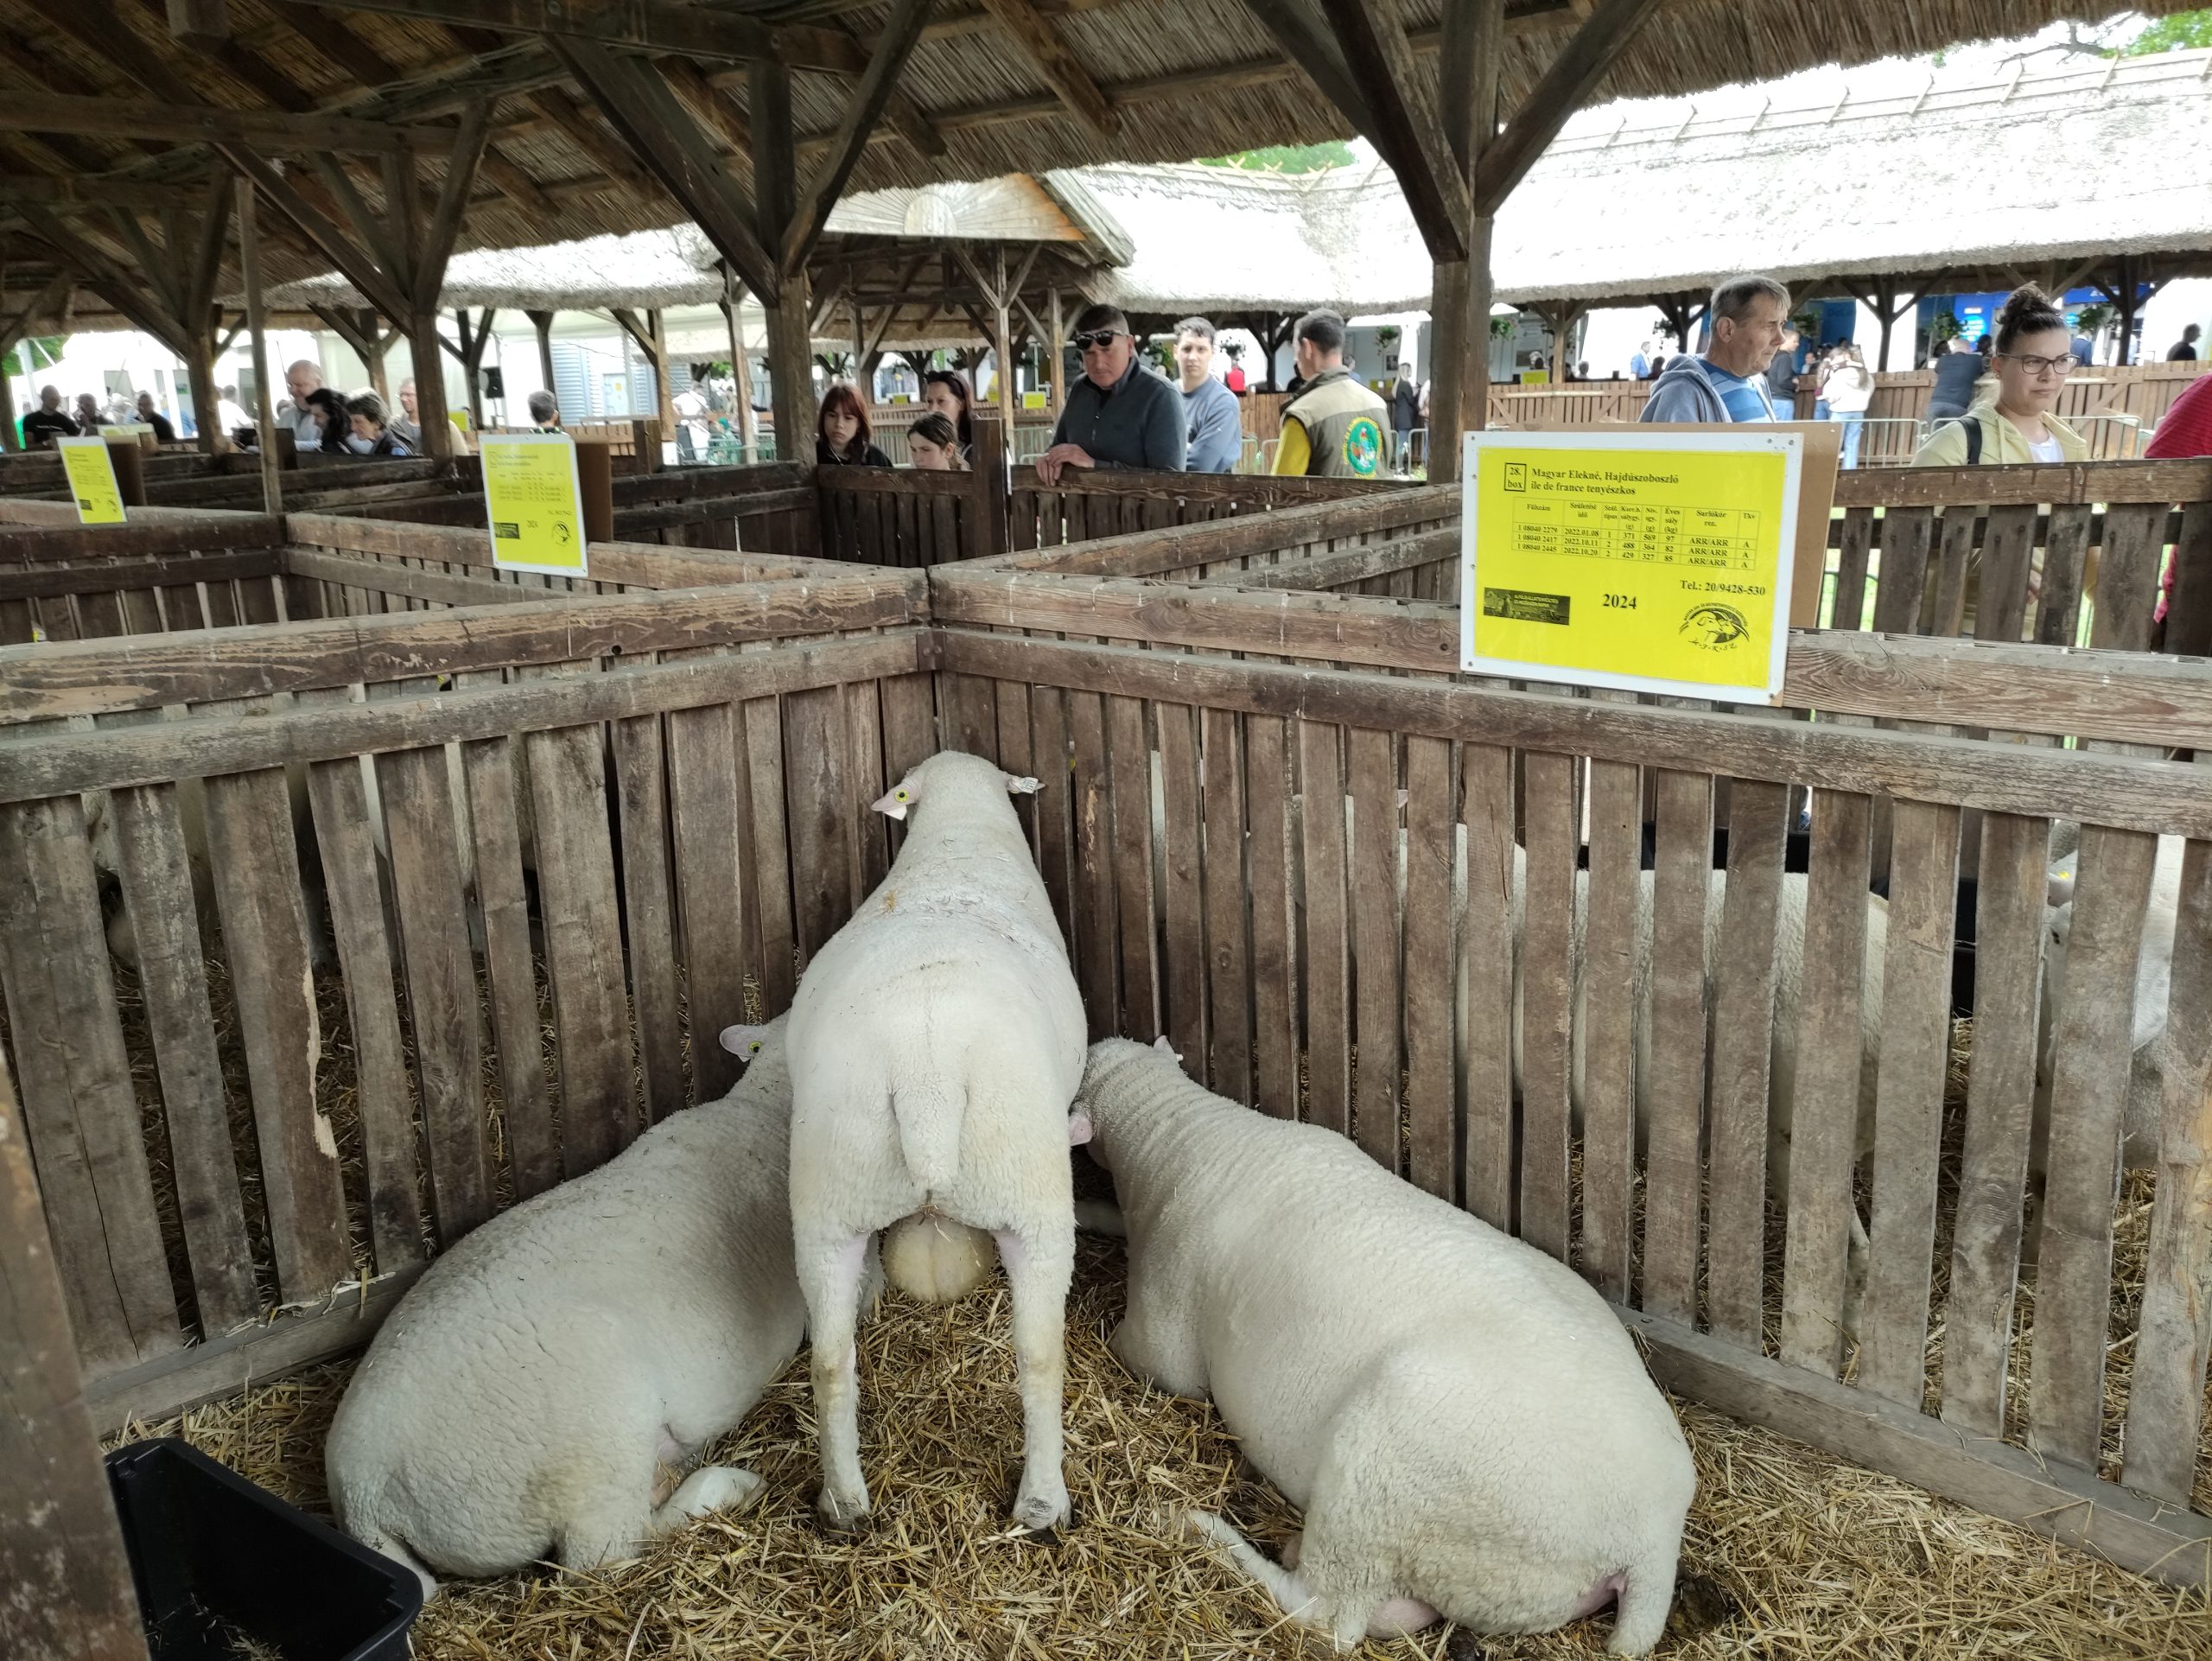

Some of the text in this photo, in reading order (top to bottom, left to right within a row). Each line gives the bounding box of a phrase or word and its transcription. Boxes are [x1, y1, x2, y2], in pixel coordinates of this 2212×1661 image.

[1510, 467, 1521, 475] 28.
[1531, 468, 1679, 484] Magyar Elekné, Hajdúszoboszló
[1507, 479, 1522, 489] box
[1543, 482, 1554, 491] de
[1556, 482, 1585, 493] france
[1586, 484, 1637, 496] tenyészkos
[1689, 537, 1729, 547] ARR/ARR
[1688, 547, 1728, 557] ARR/ARR
[1742, 550, 1749, 559] A
[1688, 557, 1727, 567] ARR/ARR
[1680, 580, 1766, 596] Tel.: 20/9428-530
[1602, 594, 1637, 610] 2024
